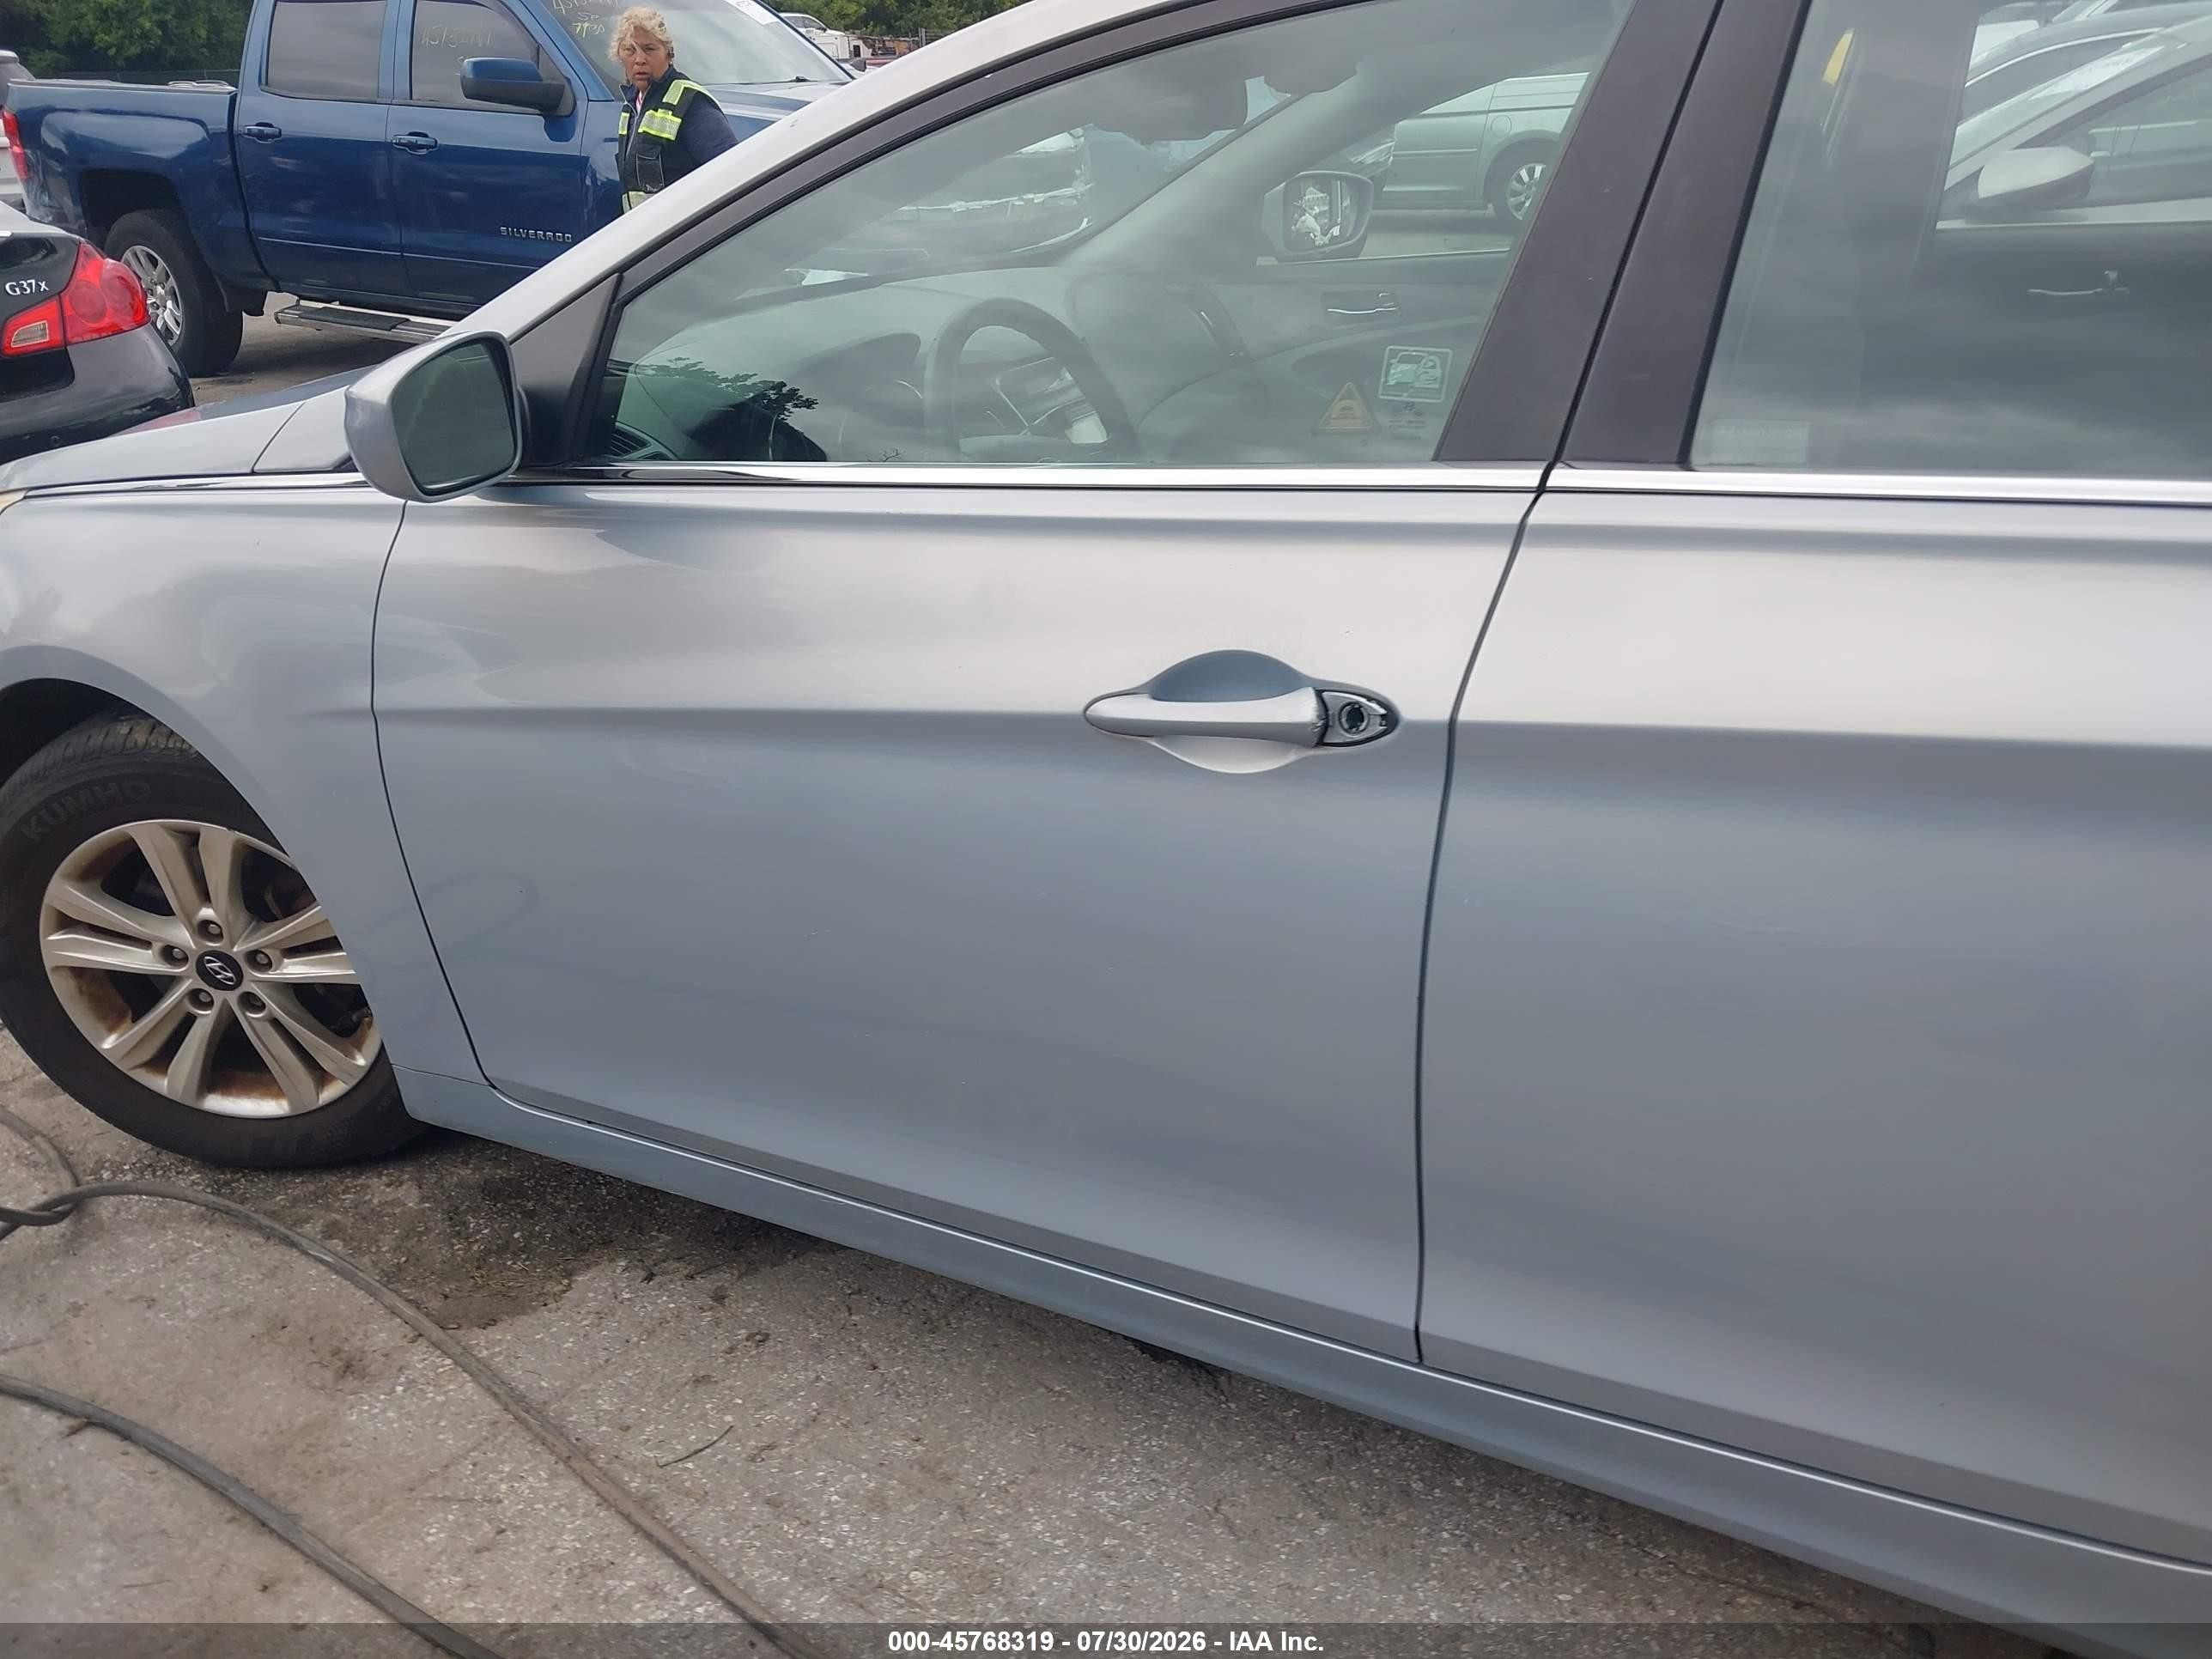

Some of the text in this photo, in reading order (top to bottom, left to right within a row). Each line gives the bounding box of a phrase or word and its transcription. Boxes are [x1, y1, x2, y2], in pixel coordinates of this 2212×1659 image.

[500, 226, 573, 243] SILVERADO
[4, 278, 50, 296] G37x
[21, 778, 152, 842] KUMHO
